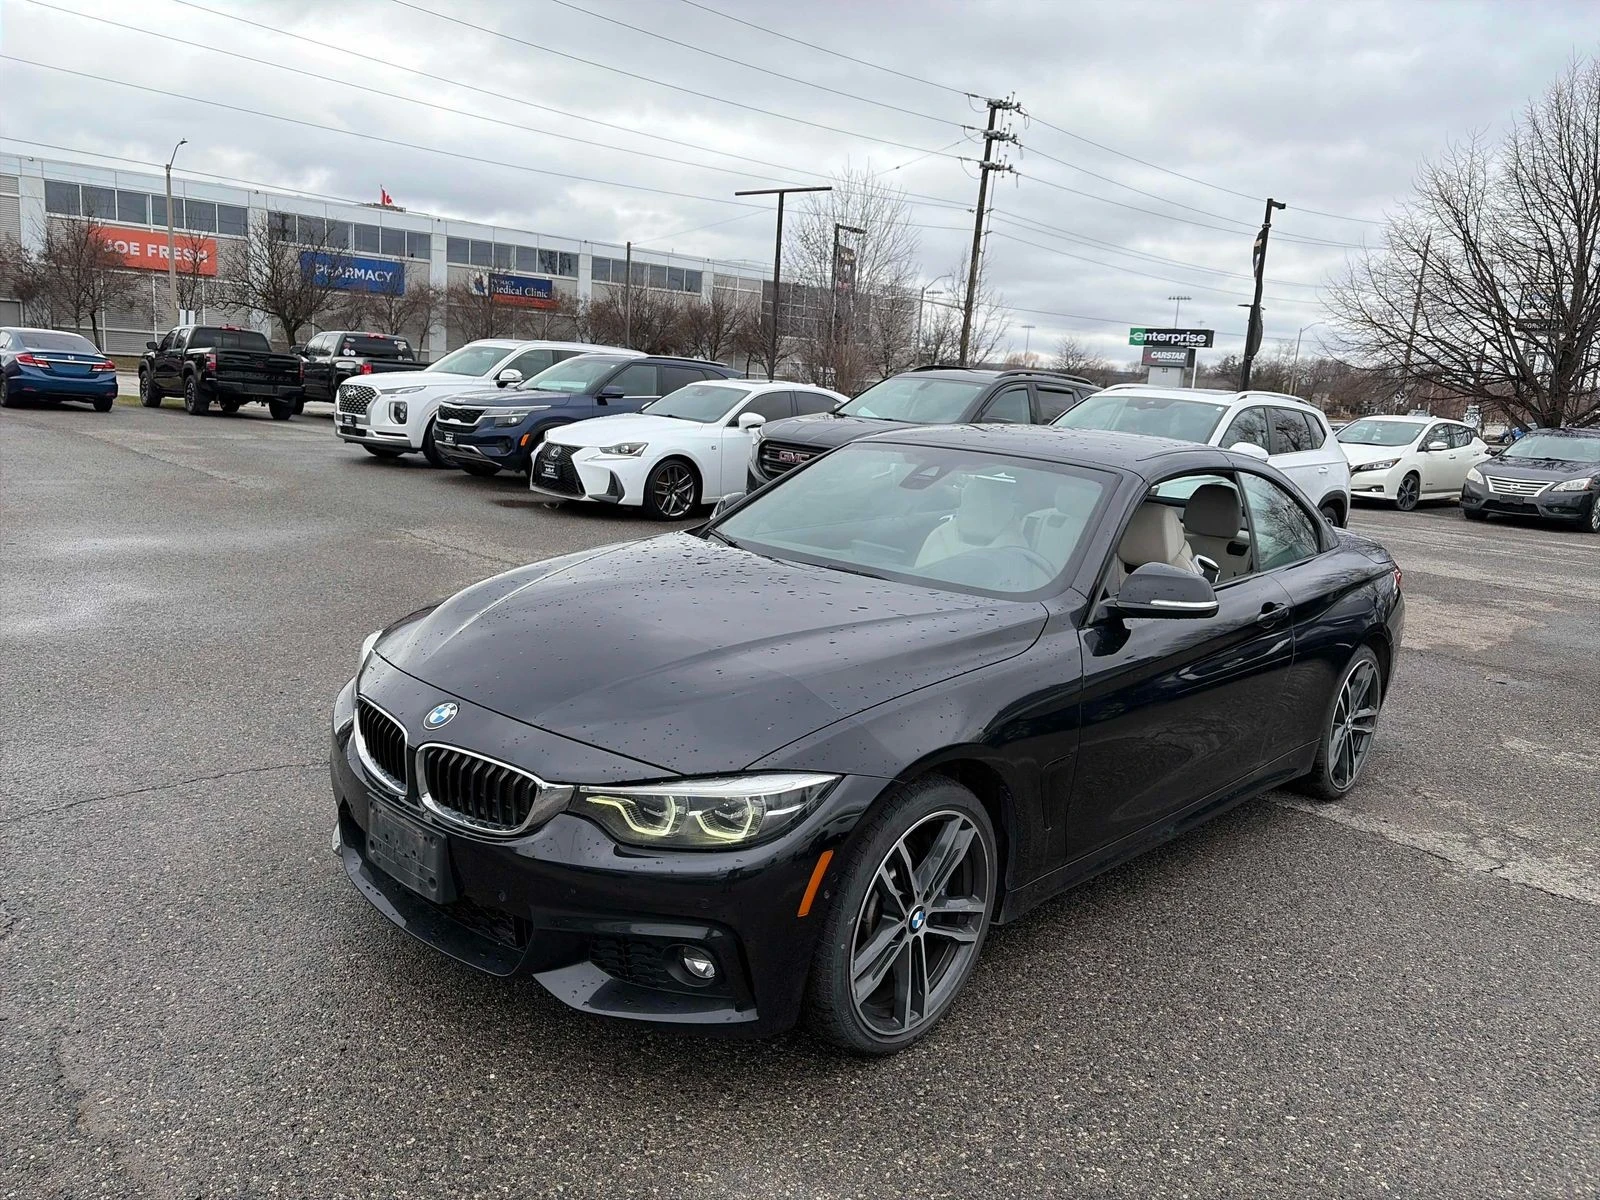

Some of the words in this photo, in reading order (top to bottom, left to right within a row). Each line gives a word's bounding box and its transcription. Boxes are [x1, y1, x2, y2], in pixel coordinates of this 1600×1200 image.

[104, 240, 140, 256] JOE
[147, 244, 208, 263] FRESH
[525, 287, 548, 298] Clinic
[1130, 332, 1207, 344] enterprise
[1151, 352, 1186, 360] CARSTAR
[780, 451, 810, 462] GMC
